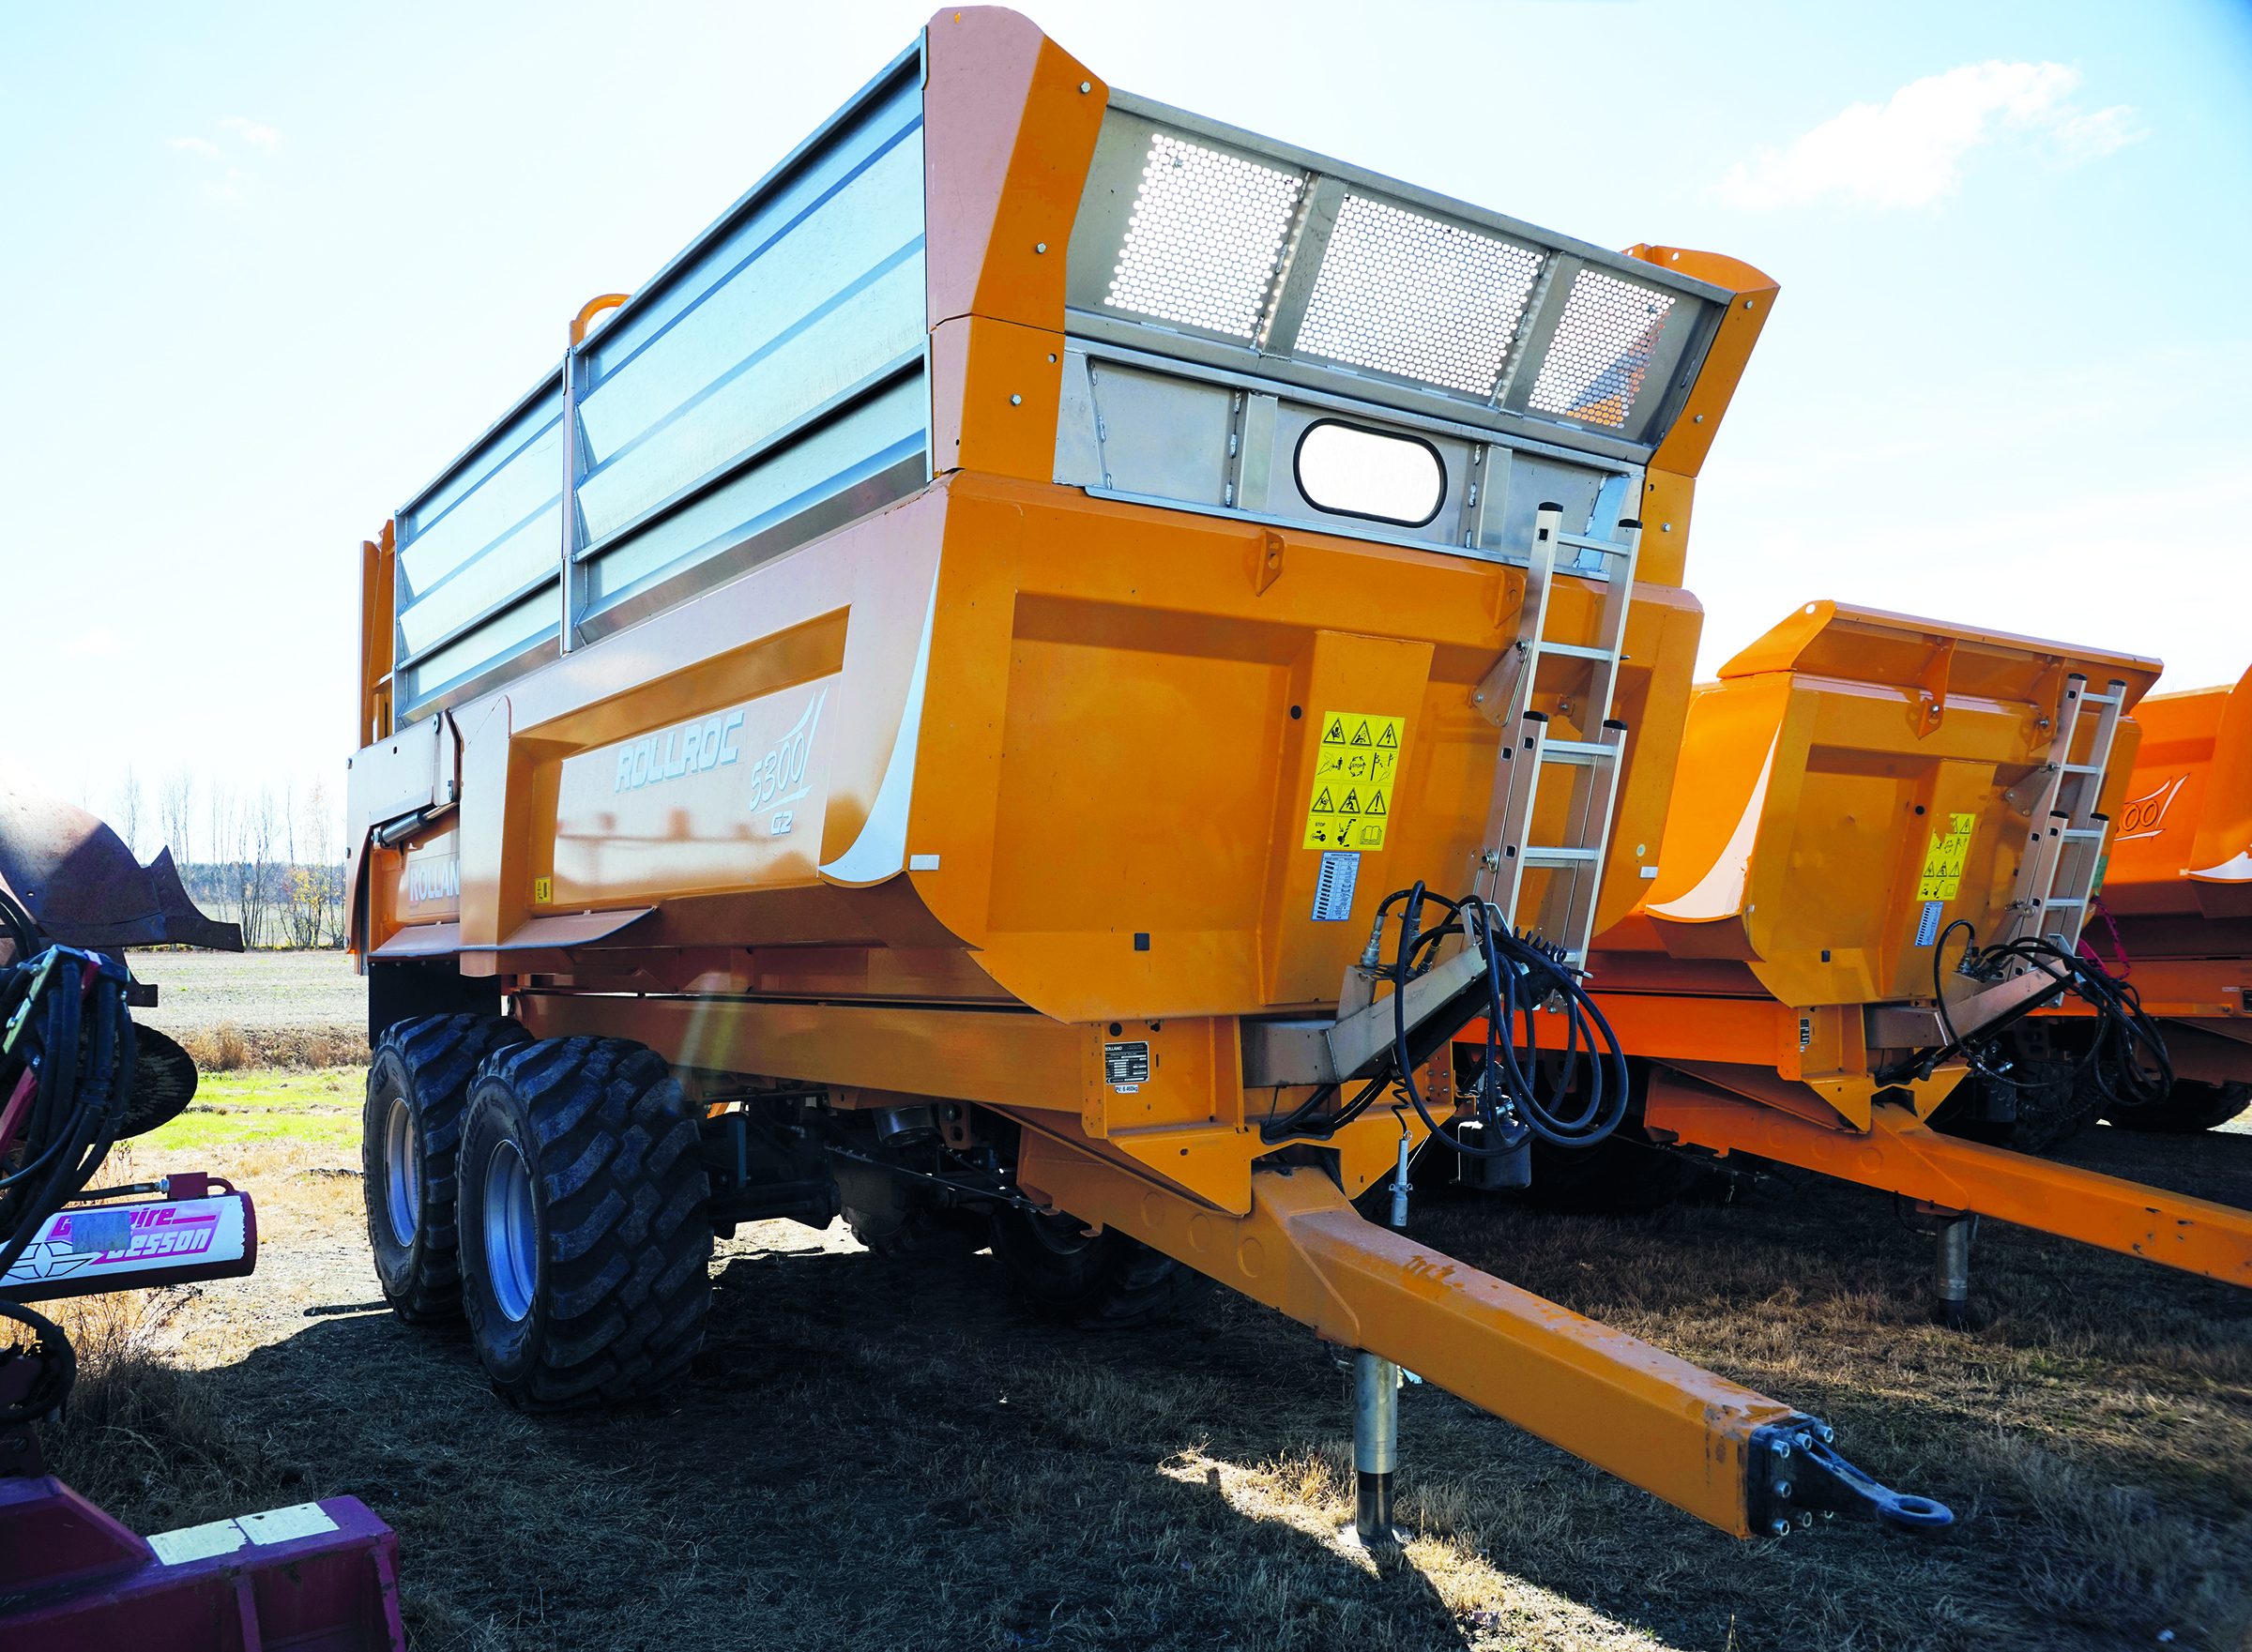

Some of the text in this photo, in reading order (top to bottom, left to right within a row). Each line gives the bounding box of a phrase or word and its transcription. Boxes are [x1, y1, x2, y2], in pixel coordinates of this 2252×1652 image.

[615, 709, 744, 794] ROLLROC
[750, 732, 806, 811] 5300
[770, 810, 794, 836] G2
[2116, 798, 2159, 833] 00
[410, 860, 460, 902] ROLLAN
